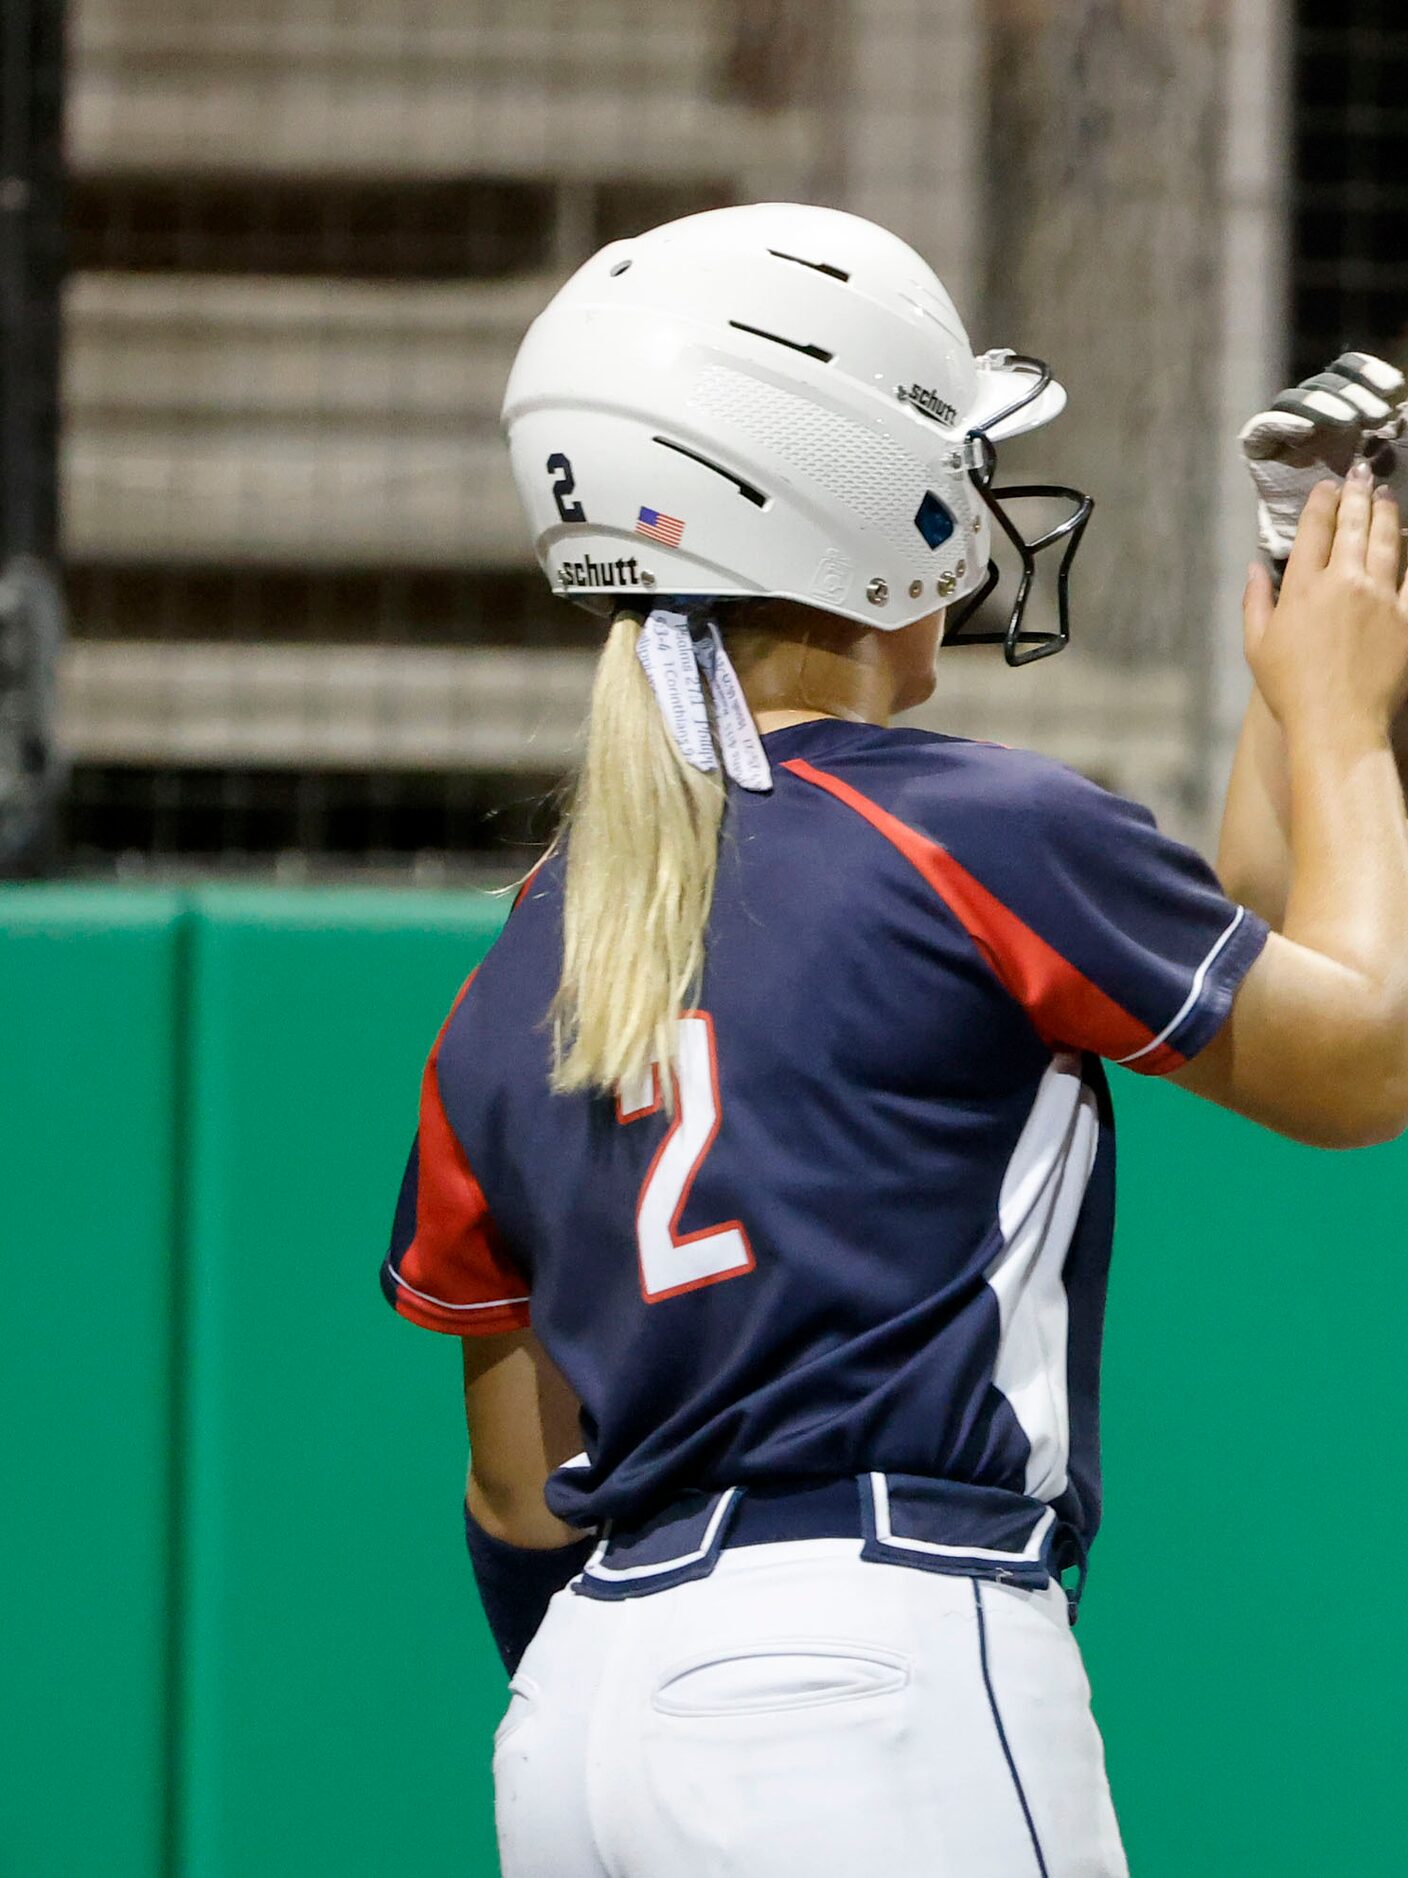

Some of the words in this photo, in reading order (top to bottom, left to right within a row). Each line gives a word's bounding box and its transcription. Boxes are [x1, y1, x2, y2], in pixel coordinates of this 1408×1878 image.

[908, 383, 957, 426] schutt
[547, 453, 587, 523] 2
[560, 554, 639, 587] schutt
[616, 1008, 757, 1305] 2
